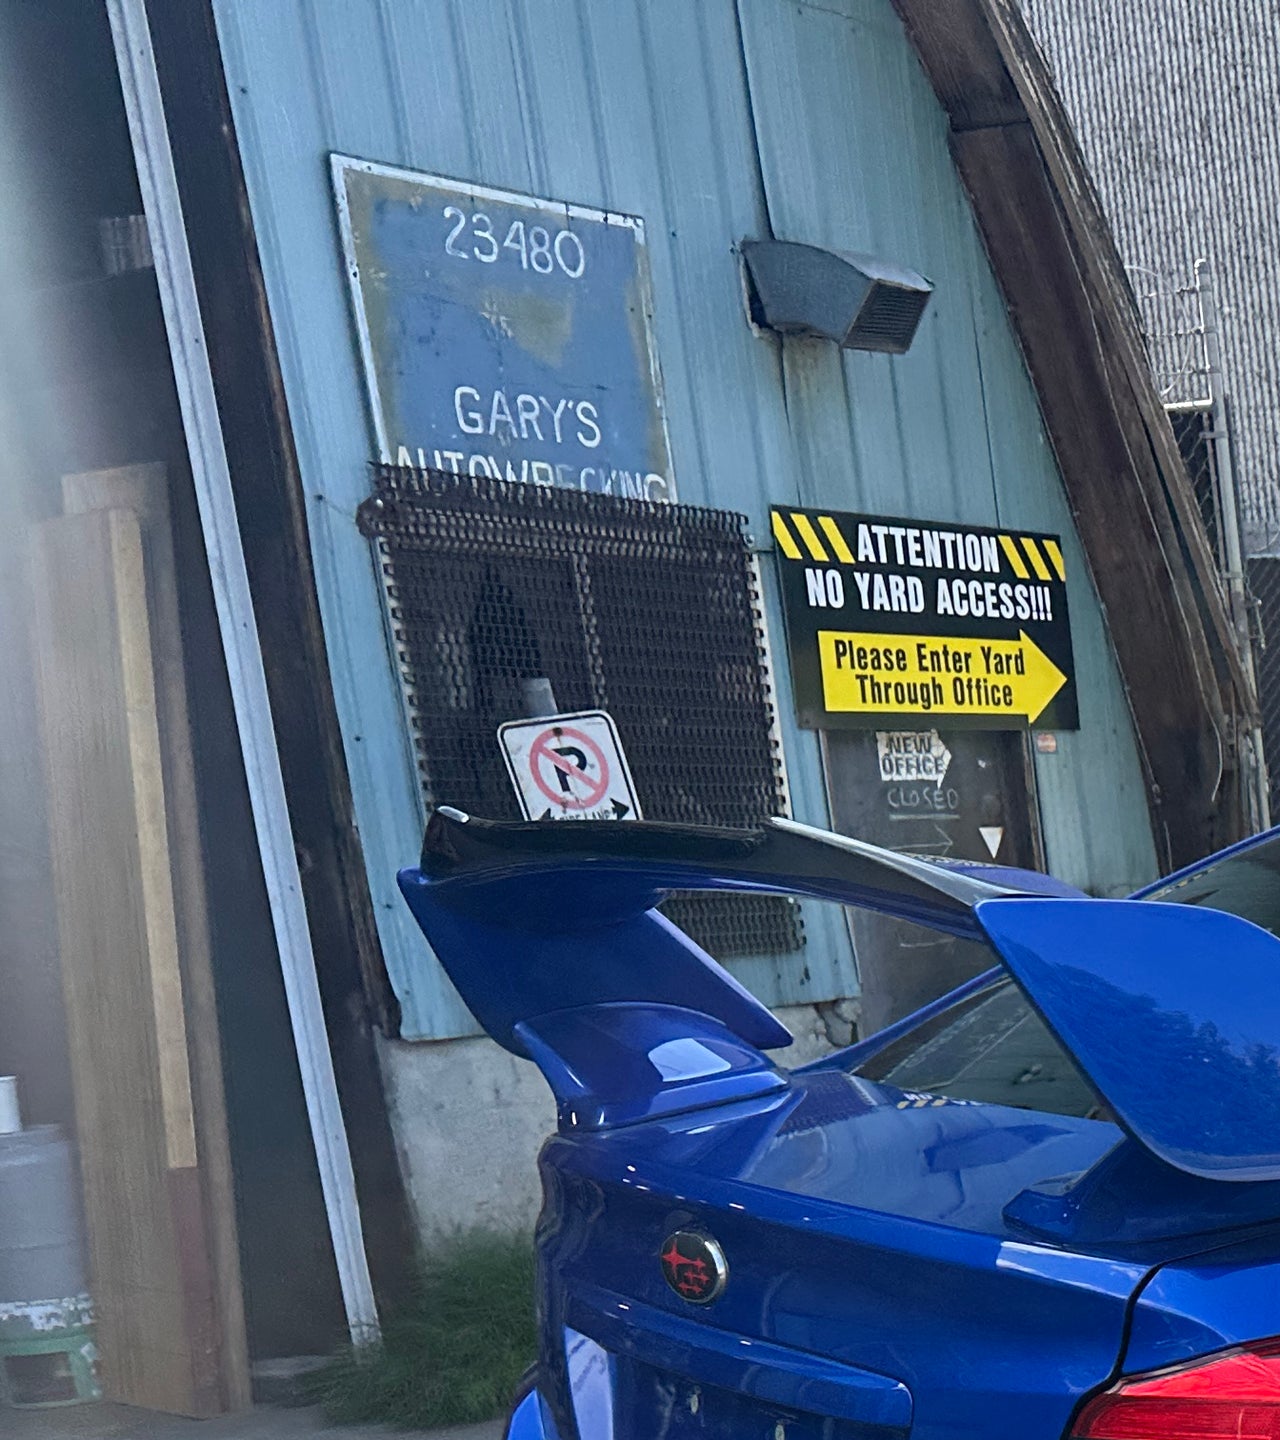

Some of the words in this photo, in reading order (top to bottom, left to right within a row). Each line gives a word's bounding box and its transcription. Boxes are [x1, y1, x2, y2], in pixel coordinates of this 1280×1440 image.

[443, 206, 585, 278] 23480
[454, 386, 602, 448] GARY'S
[857, 523, 1000, 573] ATTENTION
[804, 568, 845, 608] NO
[854, 572, 925, 613] YARD
[937, 578, 1053, 621] ACCESS!!!
[834, 639, 907, 671] Please
[917, 643, 972, 674] Enter
[981, 646, 1025, 675] Yard
[855, 674, 944, 710] Through
[953, 677, 1013, 707] Office
[885, 732, 932, 753] NEW
[882, 753, 946, 776] OFFICE
[887, 787, 960, 810] CLOSED
